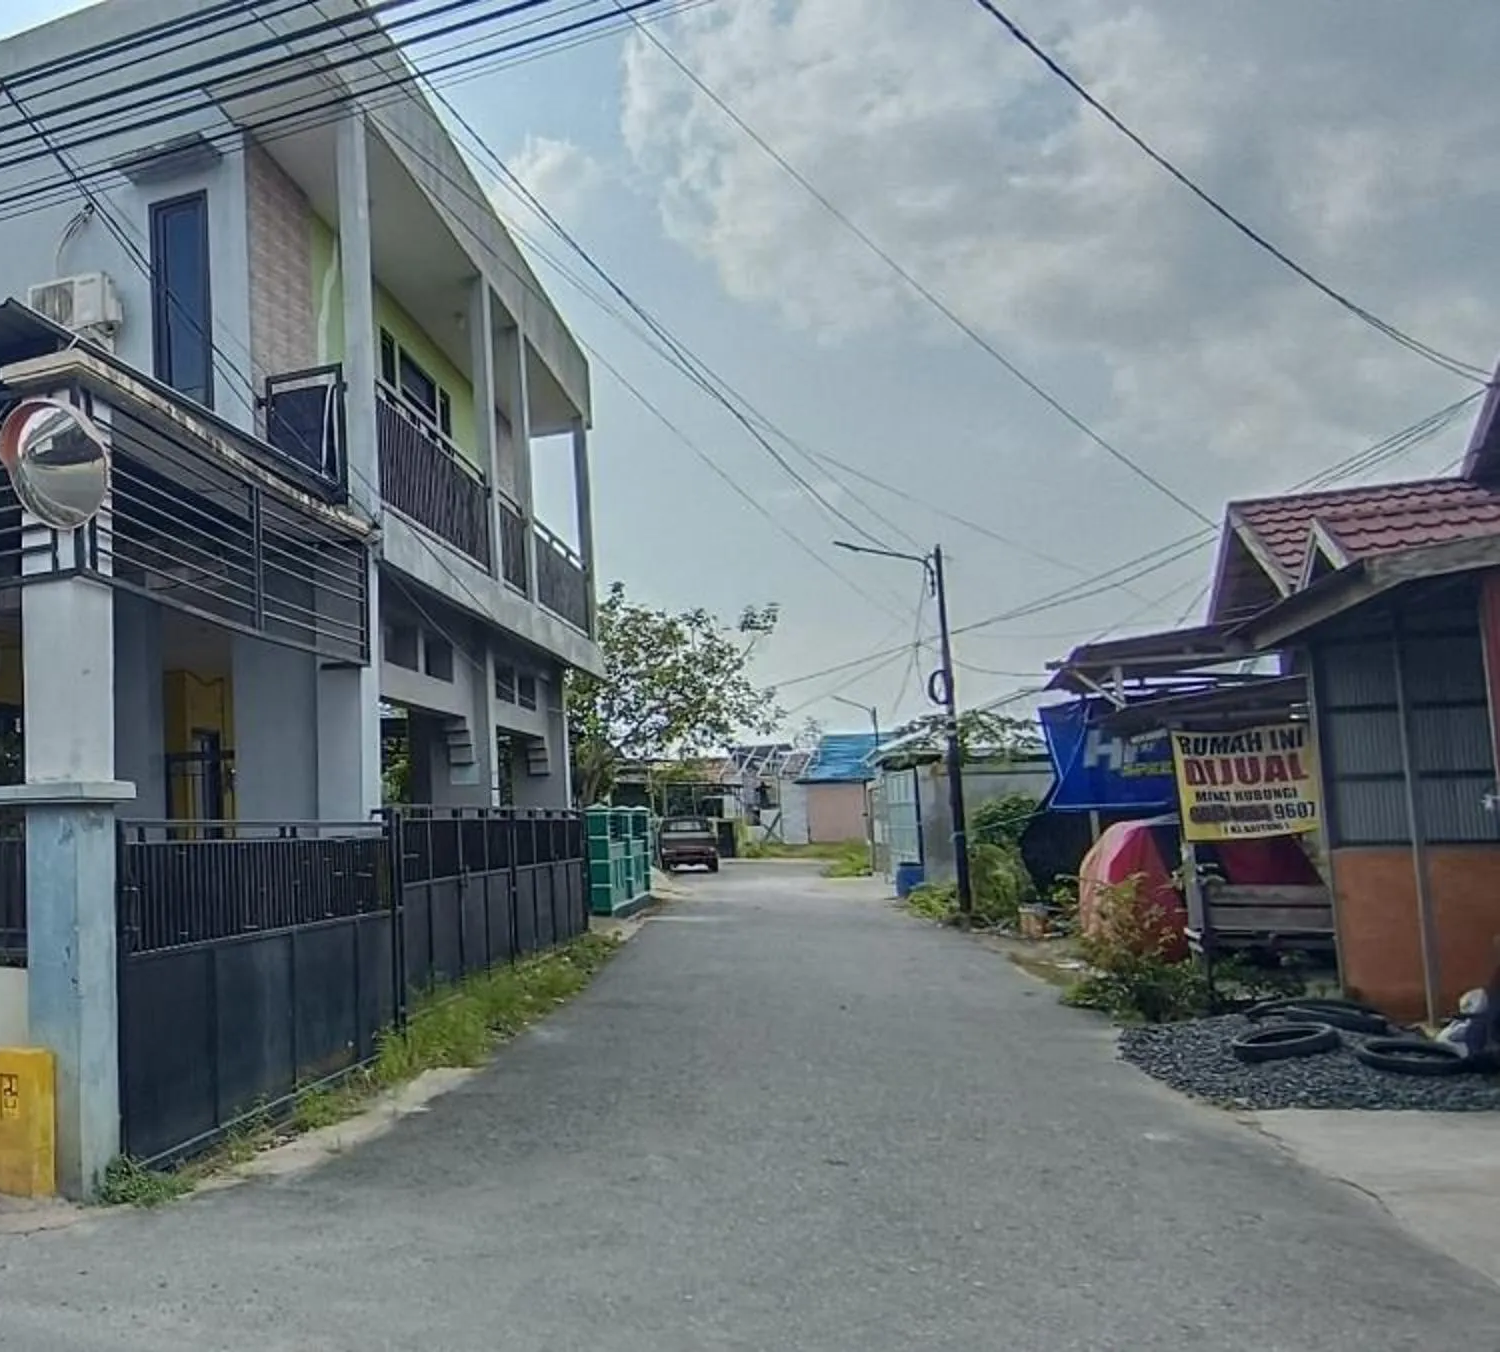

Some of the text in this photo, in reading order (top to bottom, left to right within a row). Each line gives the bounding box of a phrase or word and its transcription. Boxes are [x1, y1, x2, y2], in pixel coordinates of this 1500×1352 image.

[1177, 727, 1304, 756] RUMAH INI
[1183, 753, 1310, 786] DIJUAL
[1274, 801, 1316, 820] 9607
